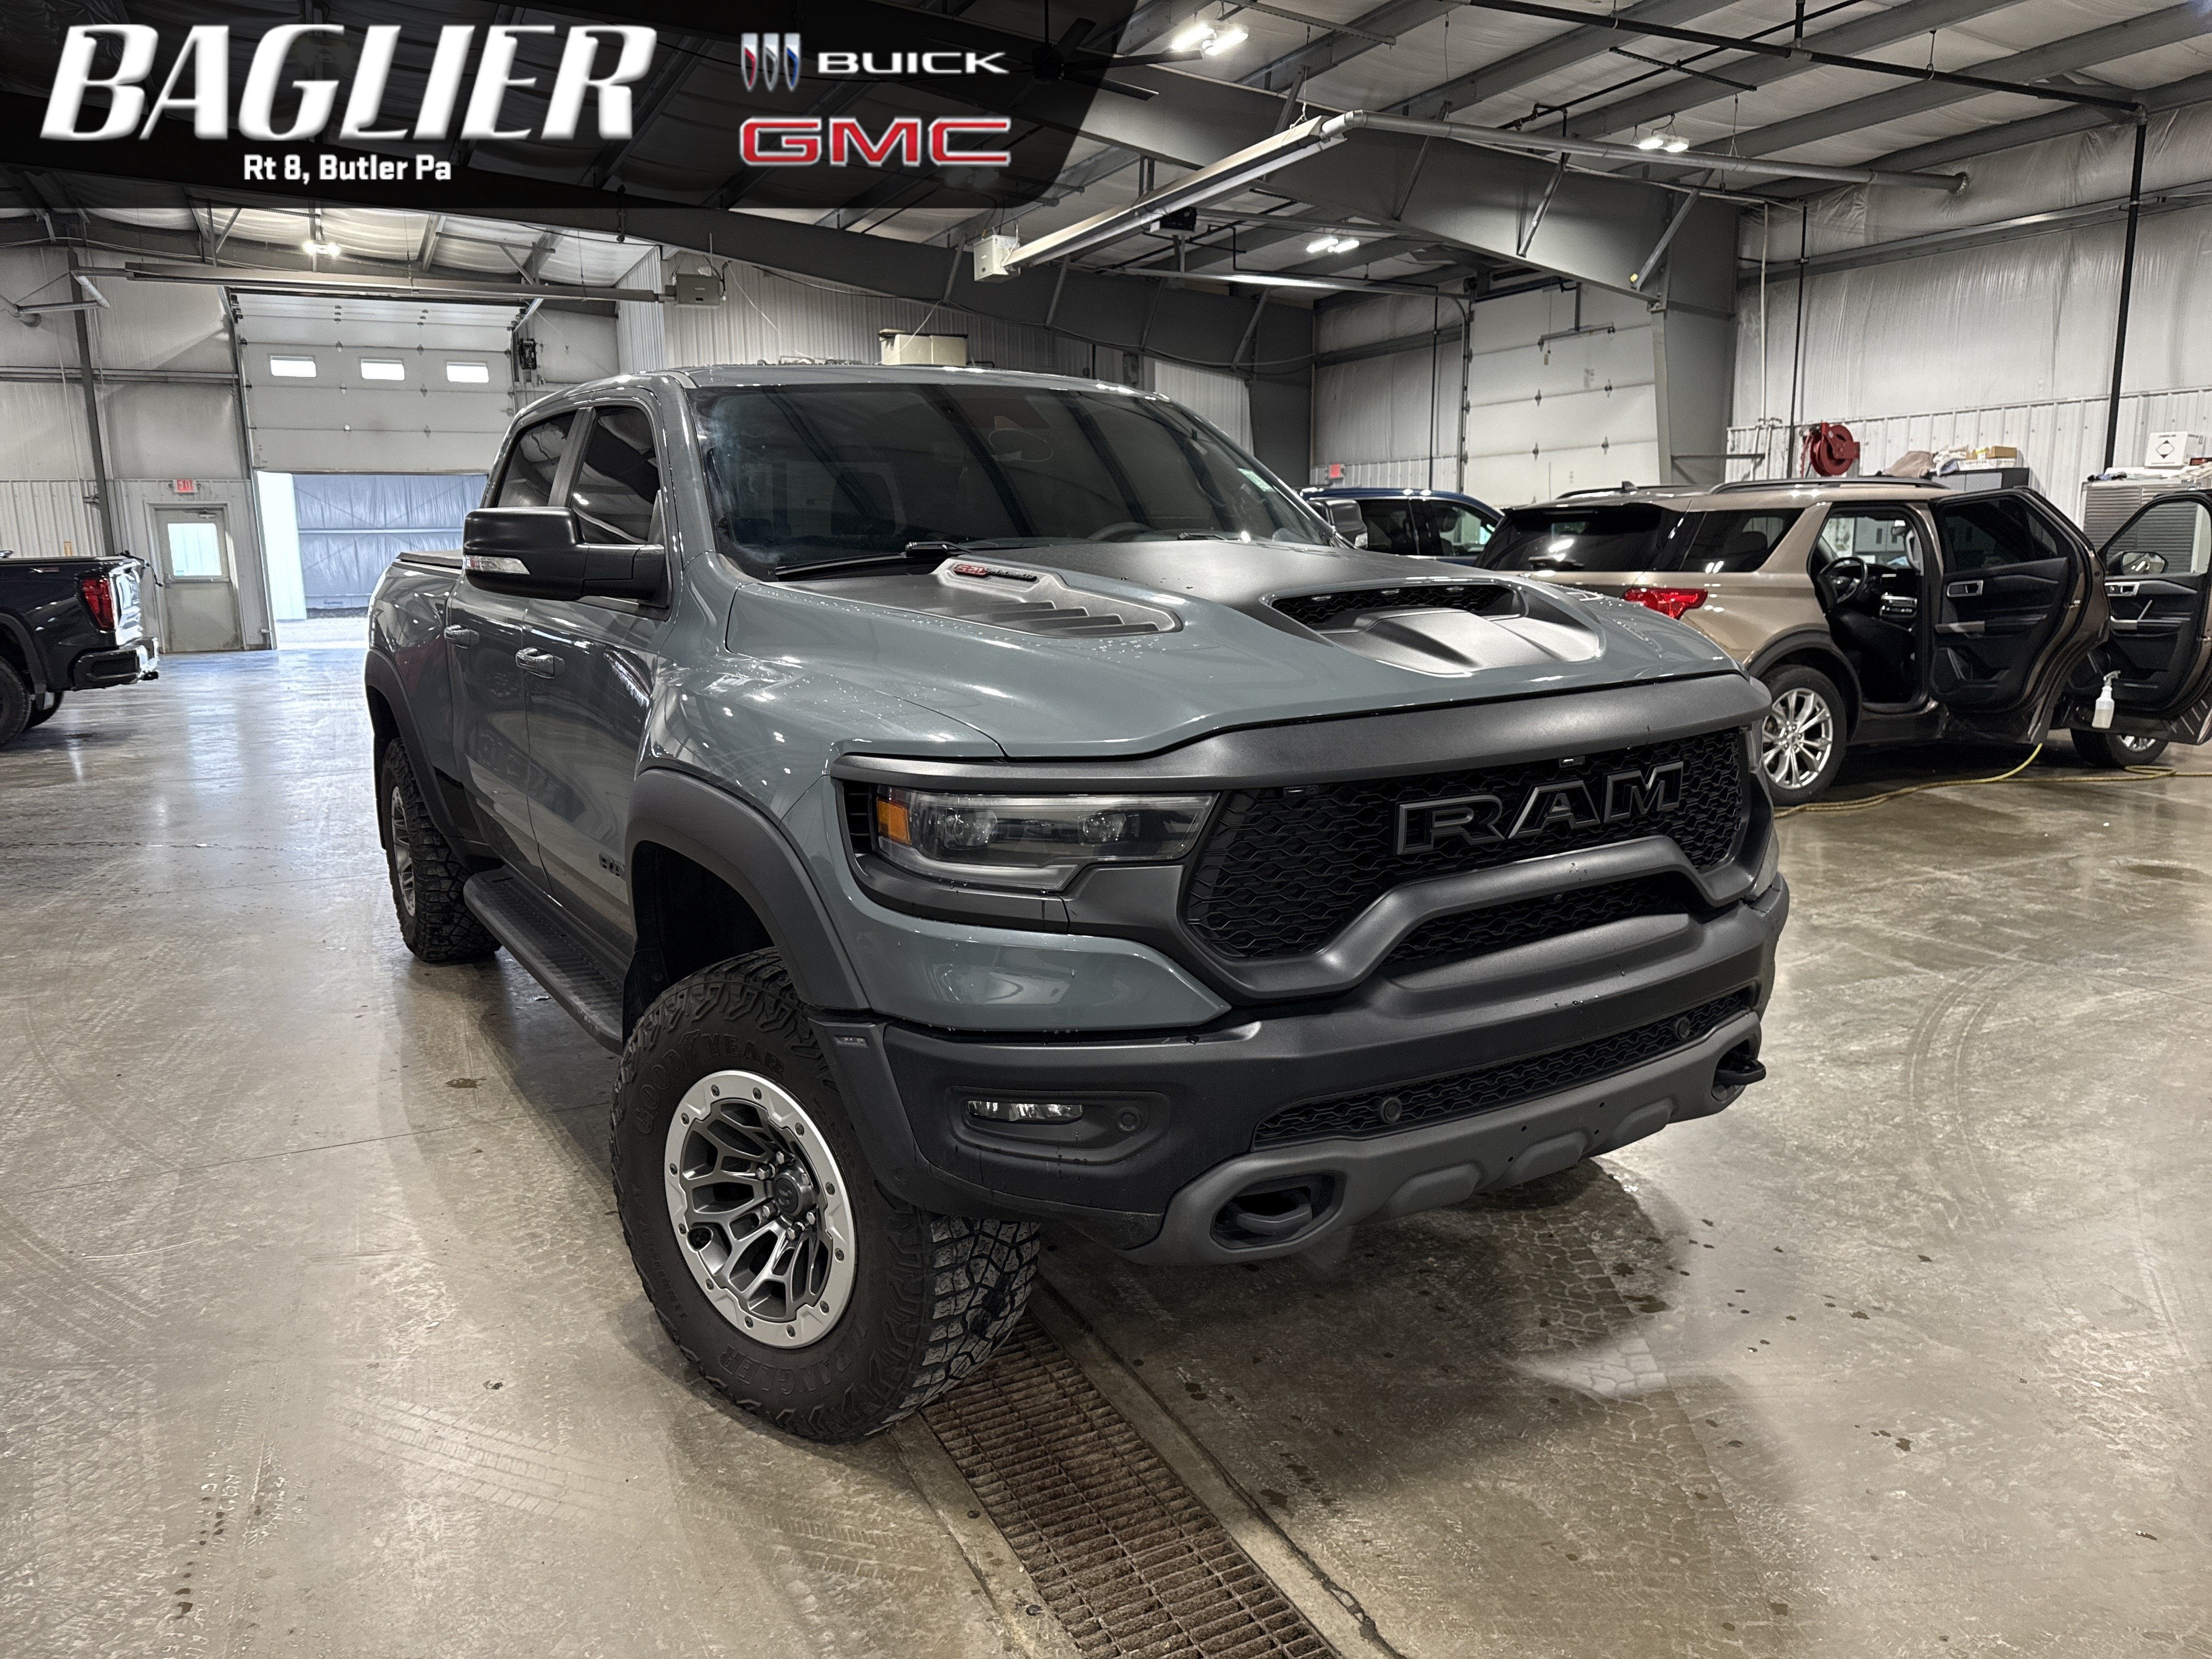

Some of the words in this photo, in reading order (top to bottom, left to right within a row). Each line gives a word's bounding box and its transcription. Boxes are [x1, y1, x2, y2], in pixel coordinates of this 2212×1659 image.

[177, 479, 193, 491] EXIT
[1396, 761, 1684, 856] RAM
[599, 852, 625, 881] RA
[634, 1029, 785, 1135] GOODYEAR
